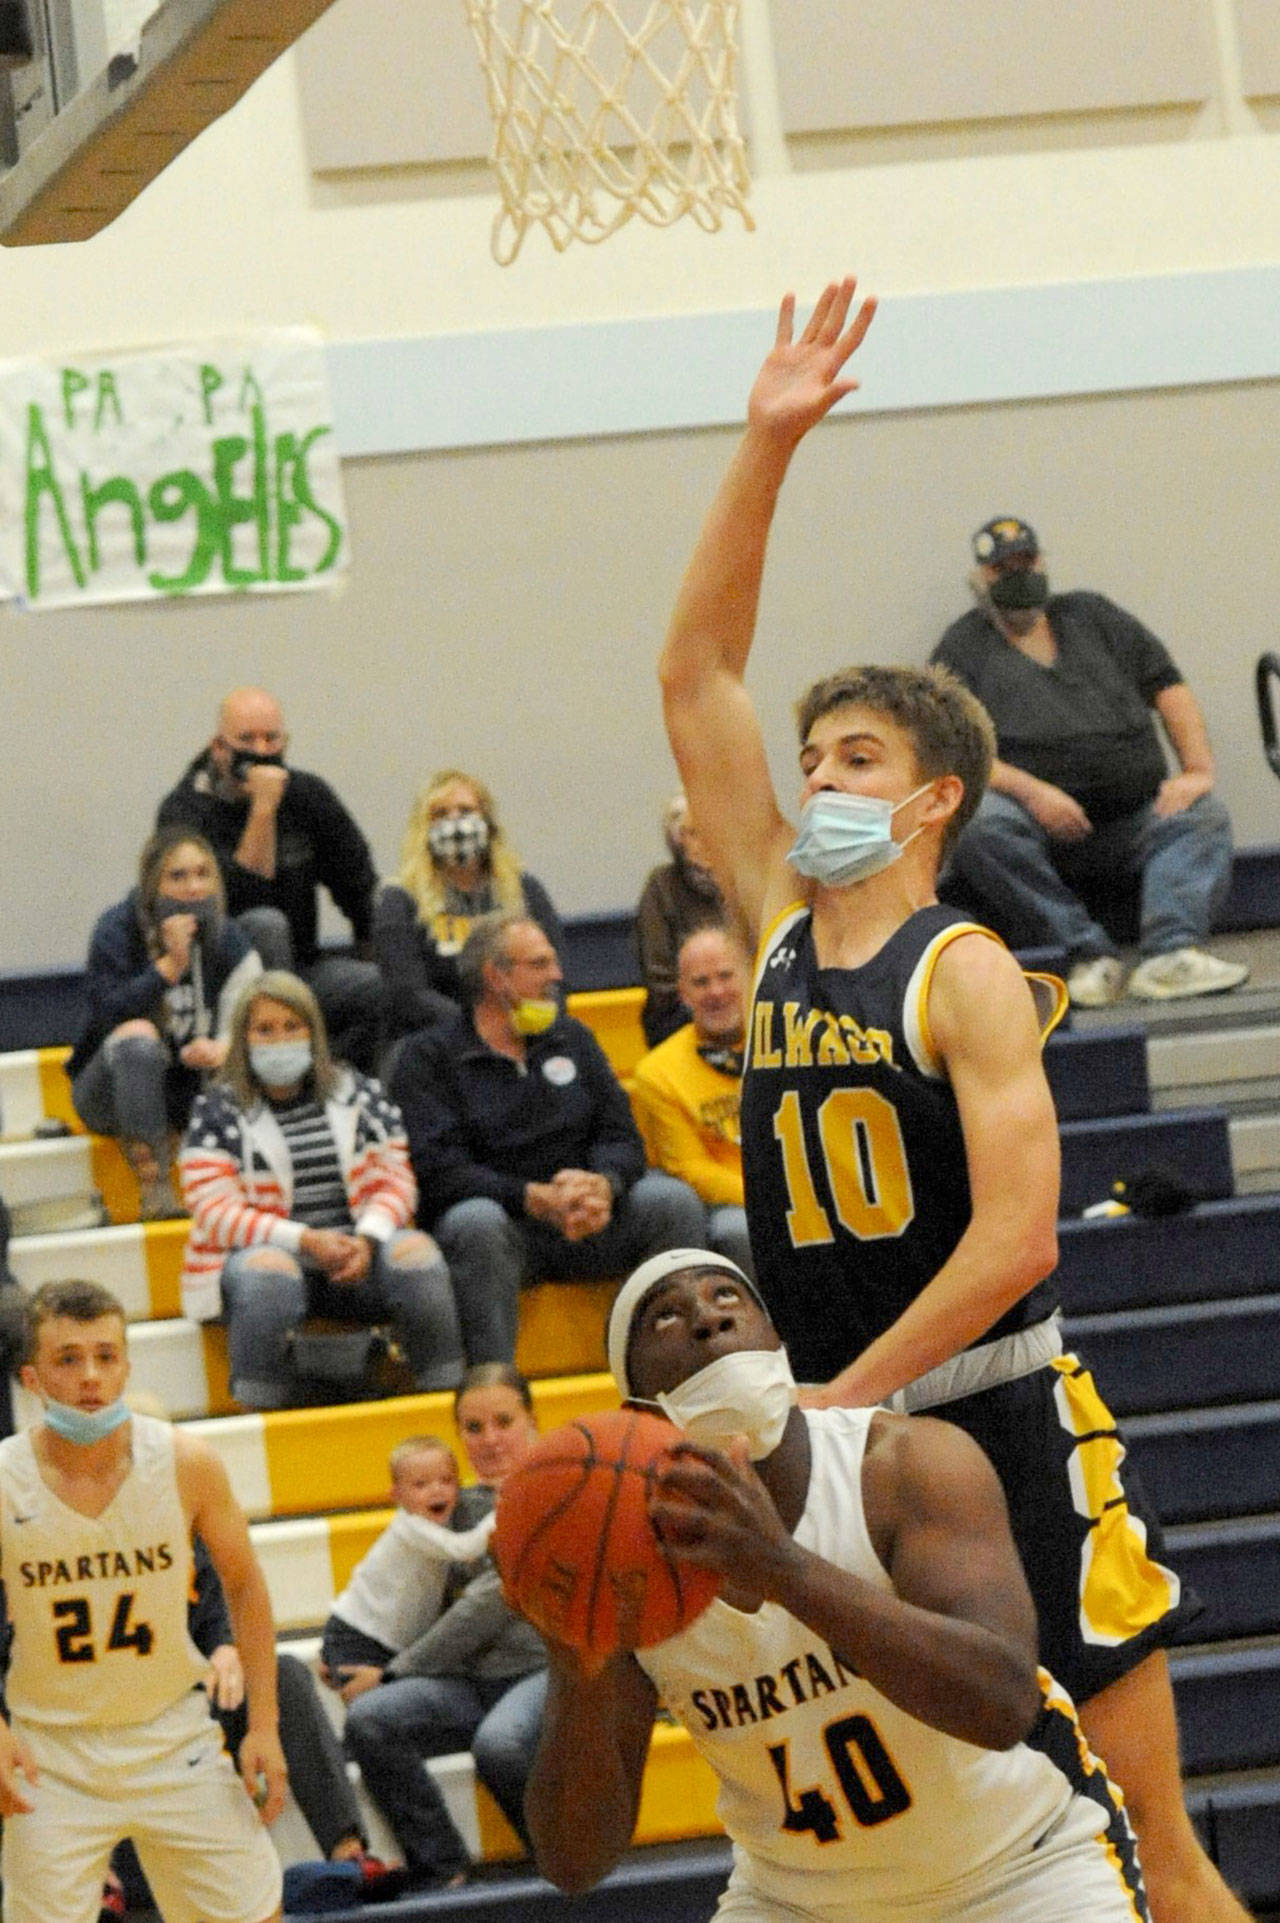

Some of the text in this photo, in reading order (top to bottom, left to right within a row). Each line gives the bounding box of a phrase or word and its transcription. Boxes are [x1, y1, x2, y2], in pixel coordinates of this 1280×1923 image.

[773, 1088, 915, 1248] 10
[20, 1543, 173, 1587] SPARTANS
[52, 1591, 154, 1663] 24
[766, 1711, 912, 1844] 40
